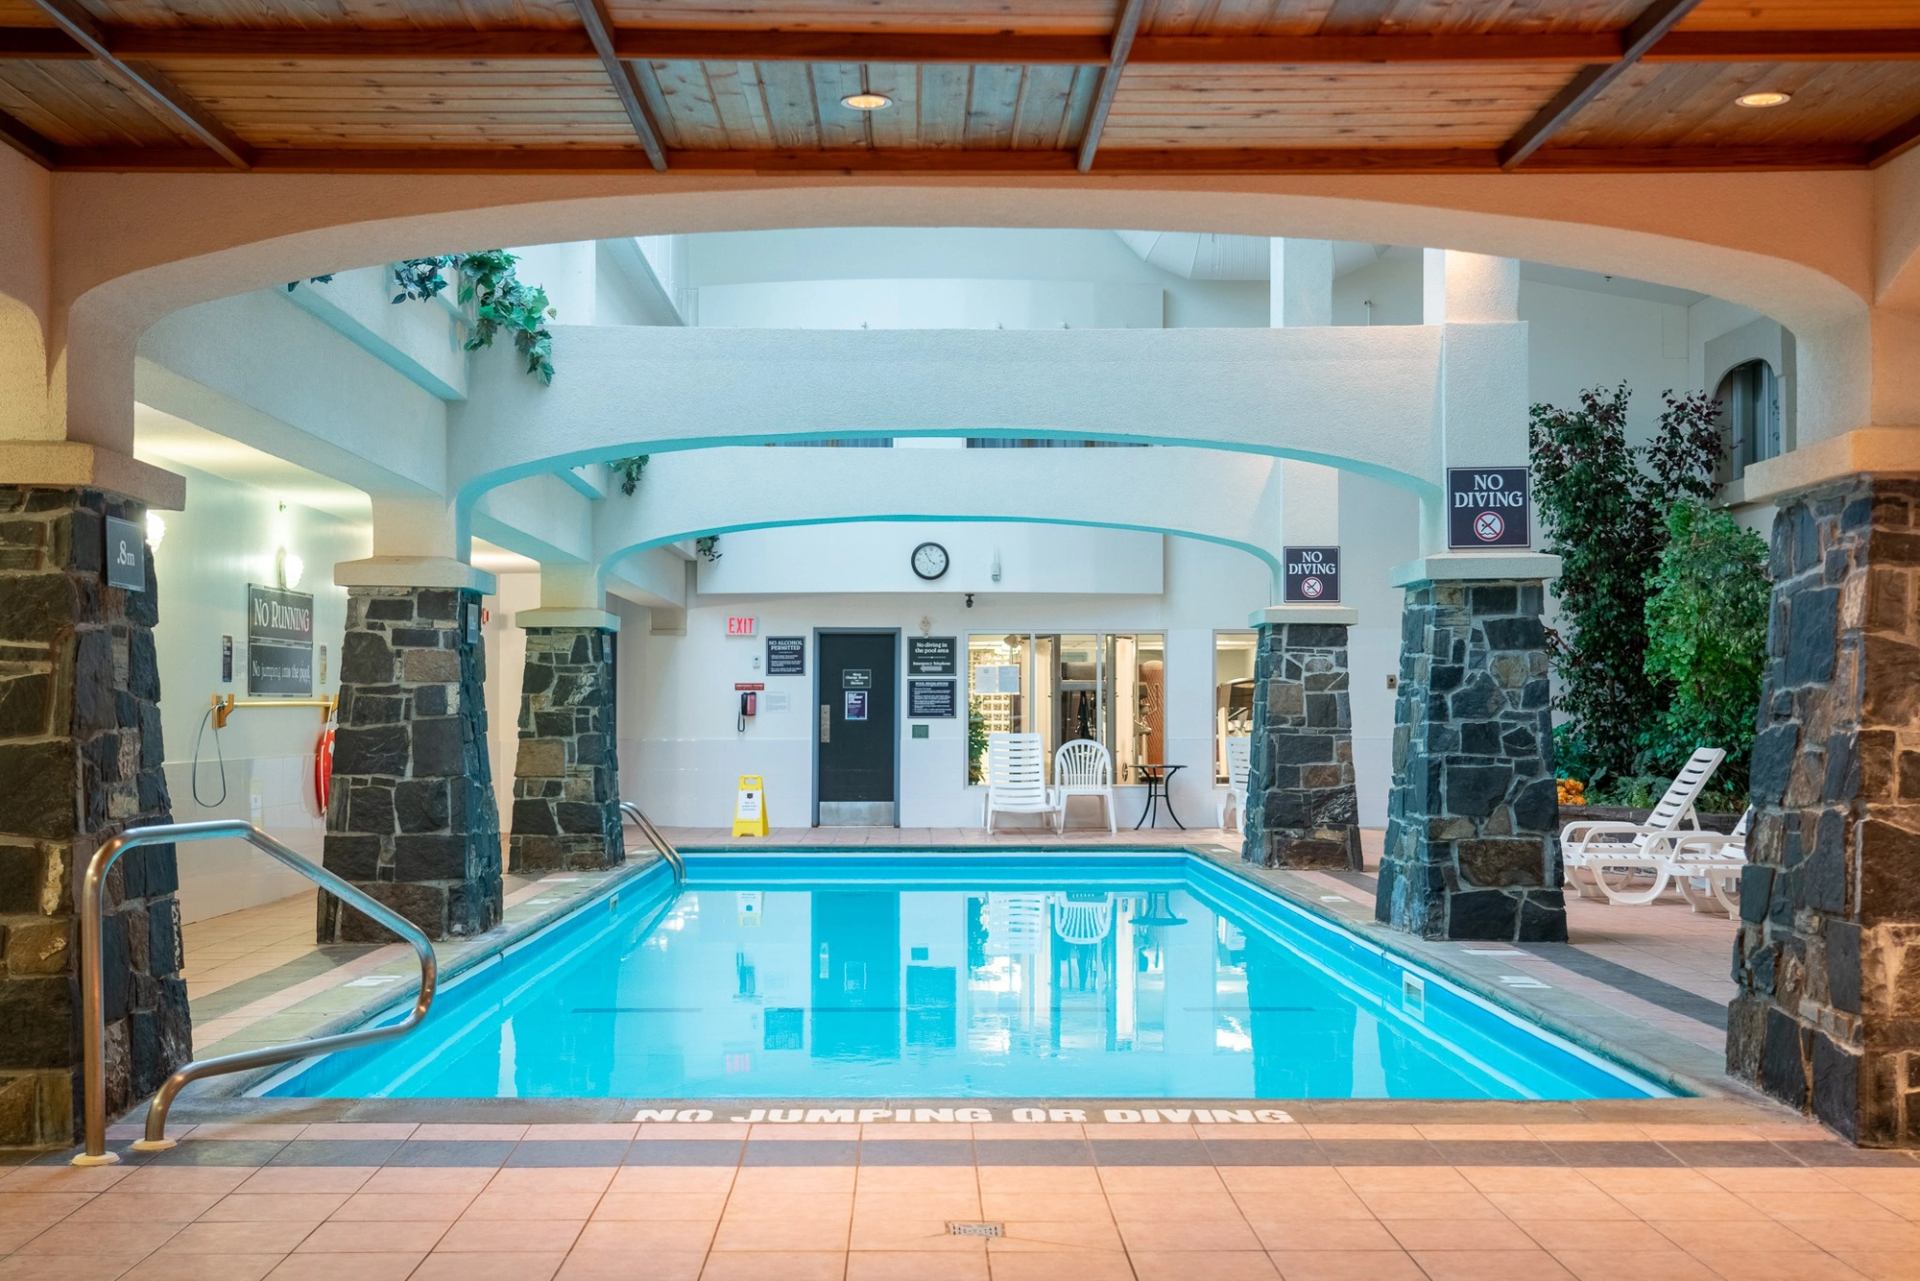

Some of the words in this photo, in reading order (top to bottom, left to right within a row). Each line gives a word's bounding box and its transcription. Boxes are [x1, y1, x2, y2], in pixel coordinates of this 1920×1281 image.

[1473, 474, 1504, 490] NO
[1454, 491, 1523, 508] DIVING
[1302, 551, 1323, 563] NO
[1288, 563, 1336, 575] DIVING
[728, 617, 753, 634] EXIT
[925, 641, 942, 649] diving
[631, 1109, 714, 1122] NO
[730, 1108, 992, 1123] JUMPING
[1012, 1108, 1088, 1123] OR
[1103, 1109, 1294, 1123] DIVING
